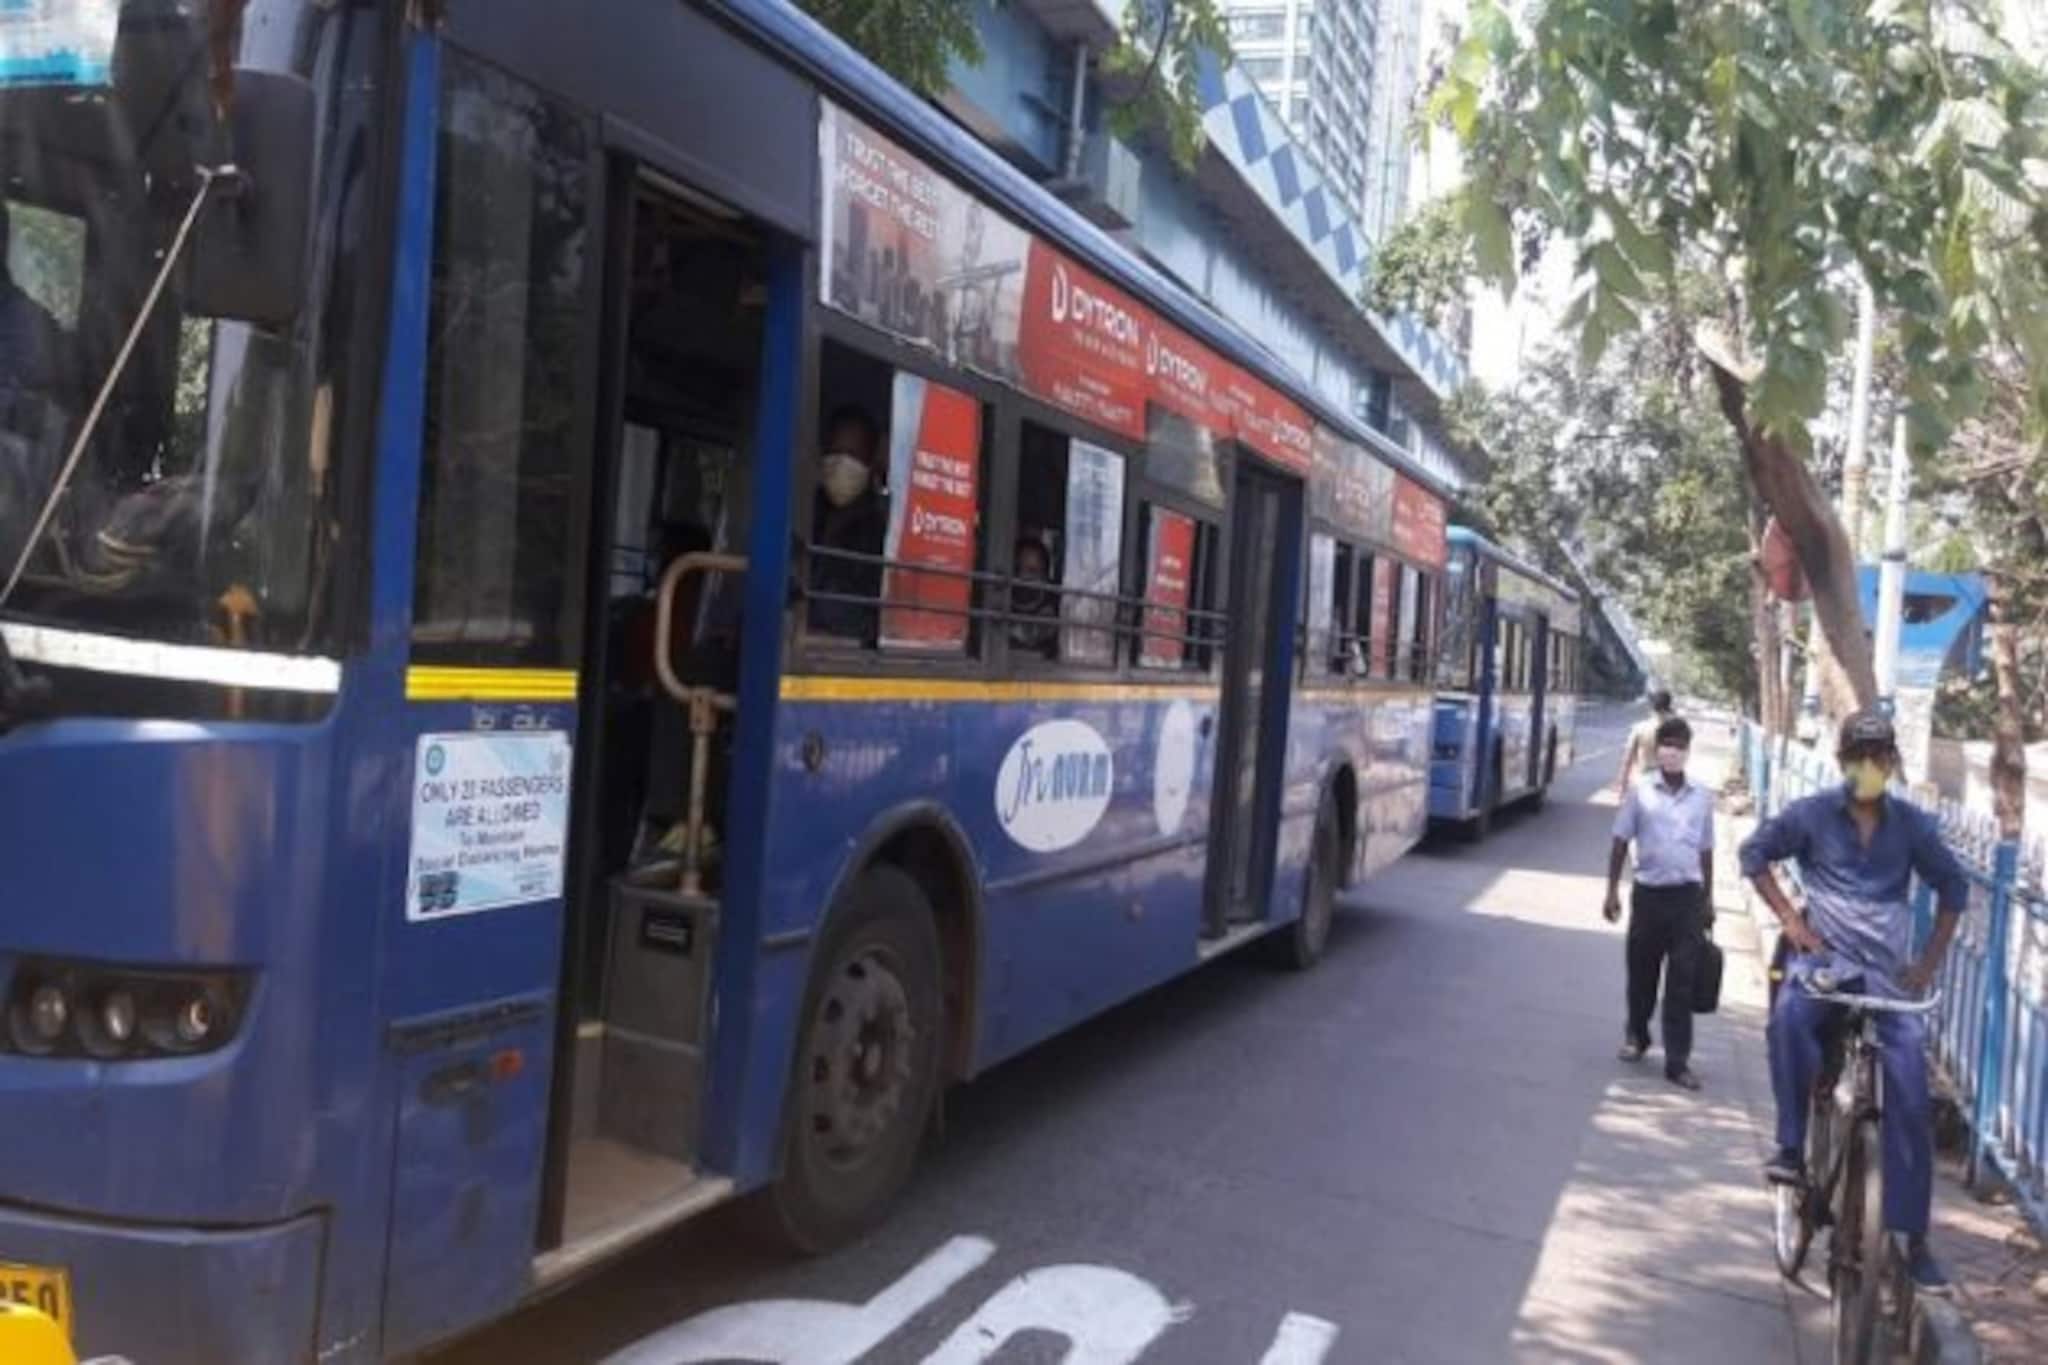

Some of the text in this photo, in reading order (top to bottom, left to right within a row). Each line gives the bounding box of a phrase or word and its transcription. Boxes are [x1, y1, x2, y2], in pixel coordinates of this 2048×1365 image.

[421, 780, 457, 804] ONLY
[480, 775, 565, 799] PASSENGERS
[445, 801, 541, 828] ARE ALLOWED
